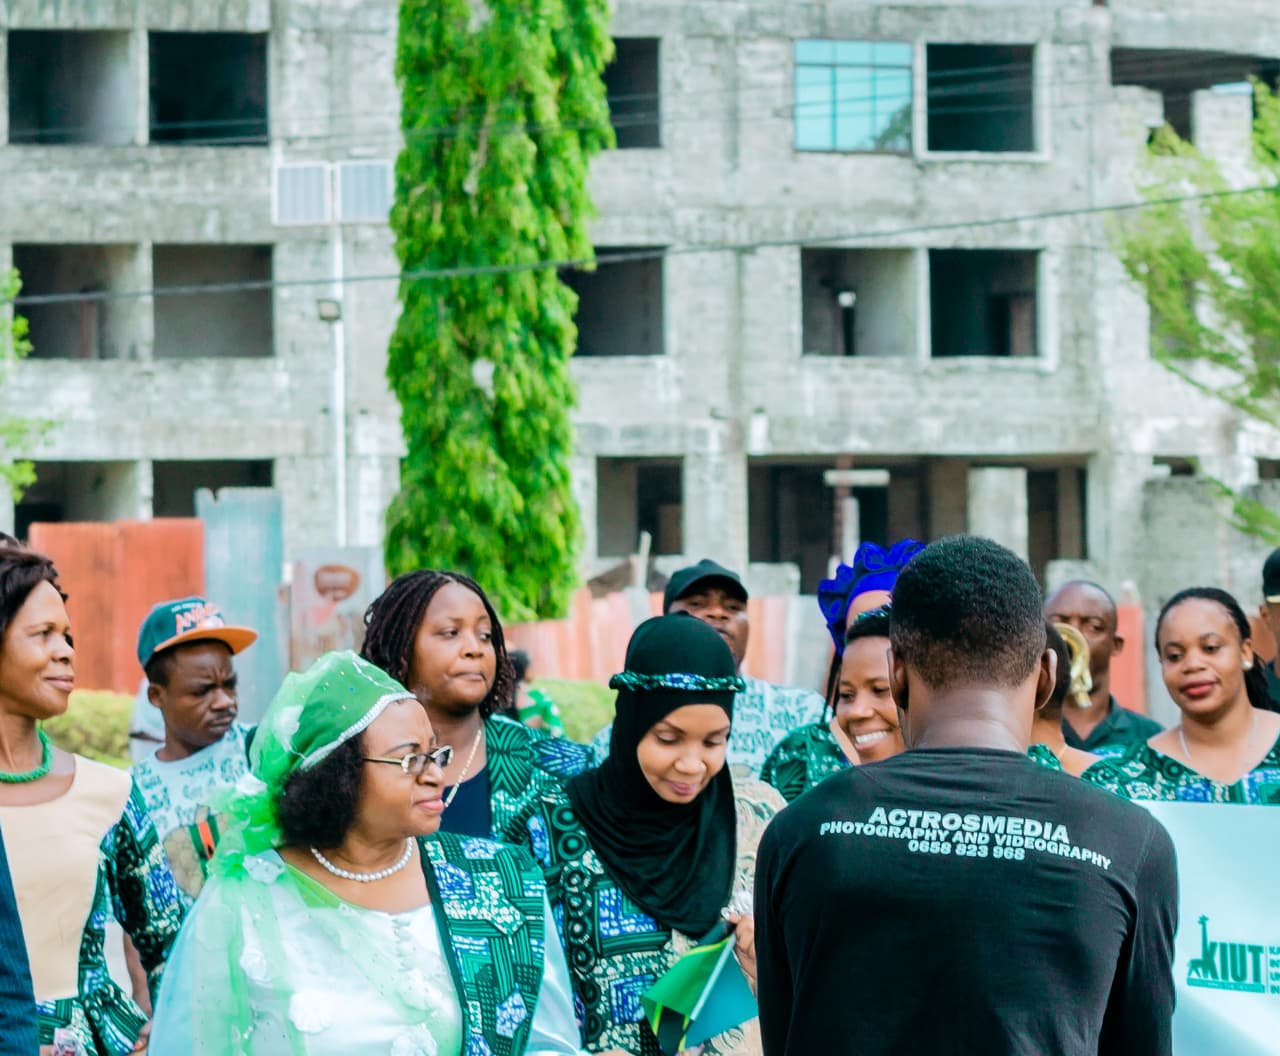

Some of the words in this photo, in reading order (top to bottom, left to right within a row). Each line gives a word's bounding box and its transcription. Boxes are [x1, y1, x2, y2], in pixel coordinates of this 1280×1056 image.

[868, 806, 1070, 843] ACTROSMEDIA
[820, 820, 949, 842] PHOTOGRAPHY
[952, 829, 990, 845] AND
[995, 833, 1112, 871] VIDEOGRAPHY
[908, 839, 952, 856] 0658
[955, 842, 988, 858] 823
[992, 844, 1026, 861] 968
[1202, 941, 1265, 984] KIUT
[1270, 985, 1280, 995] IN
